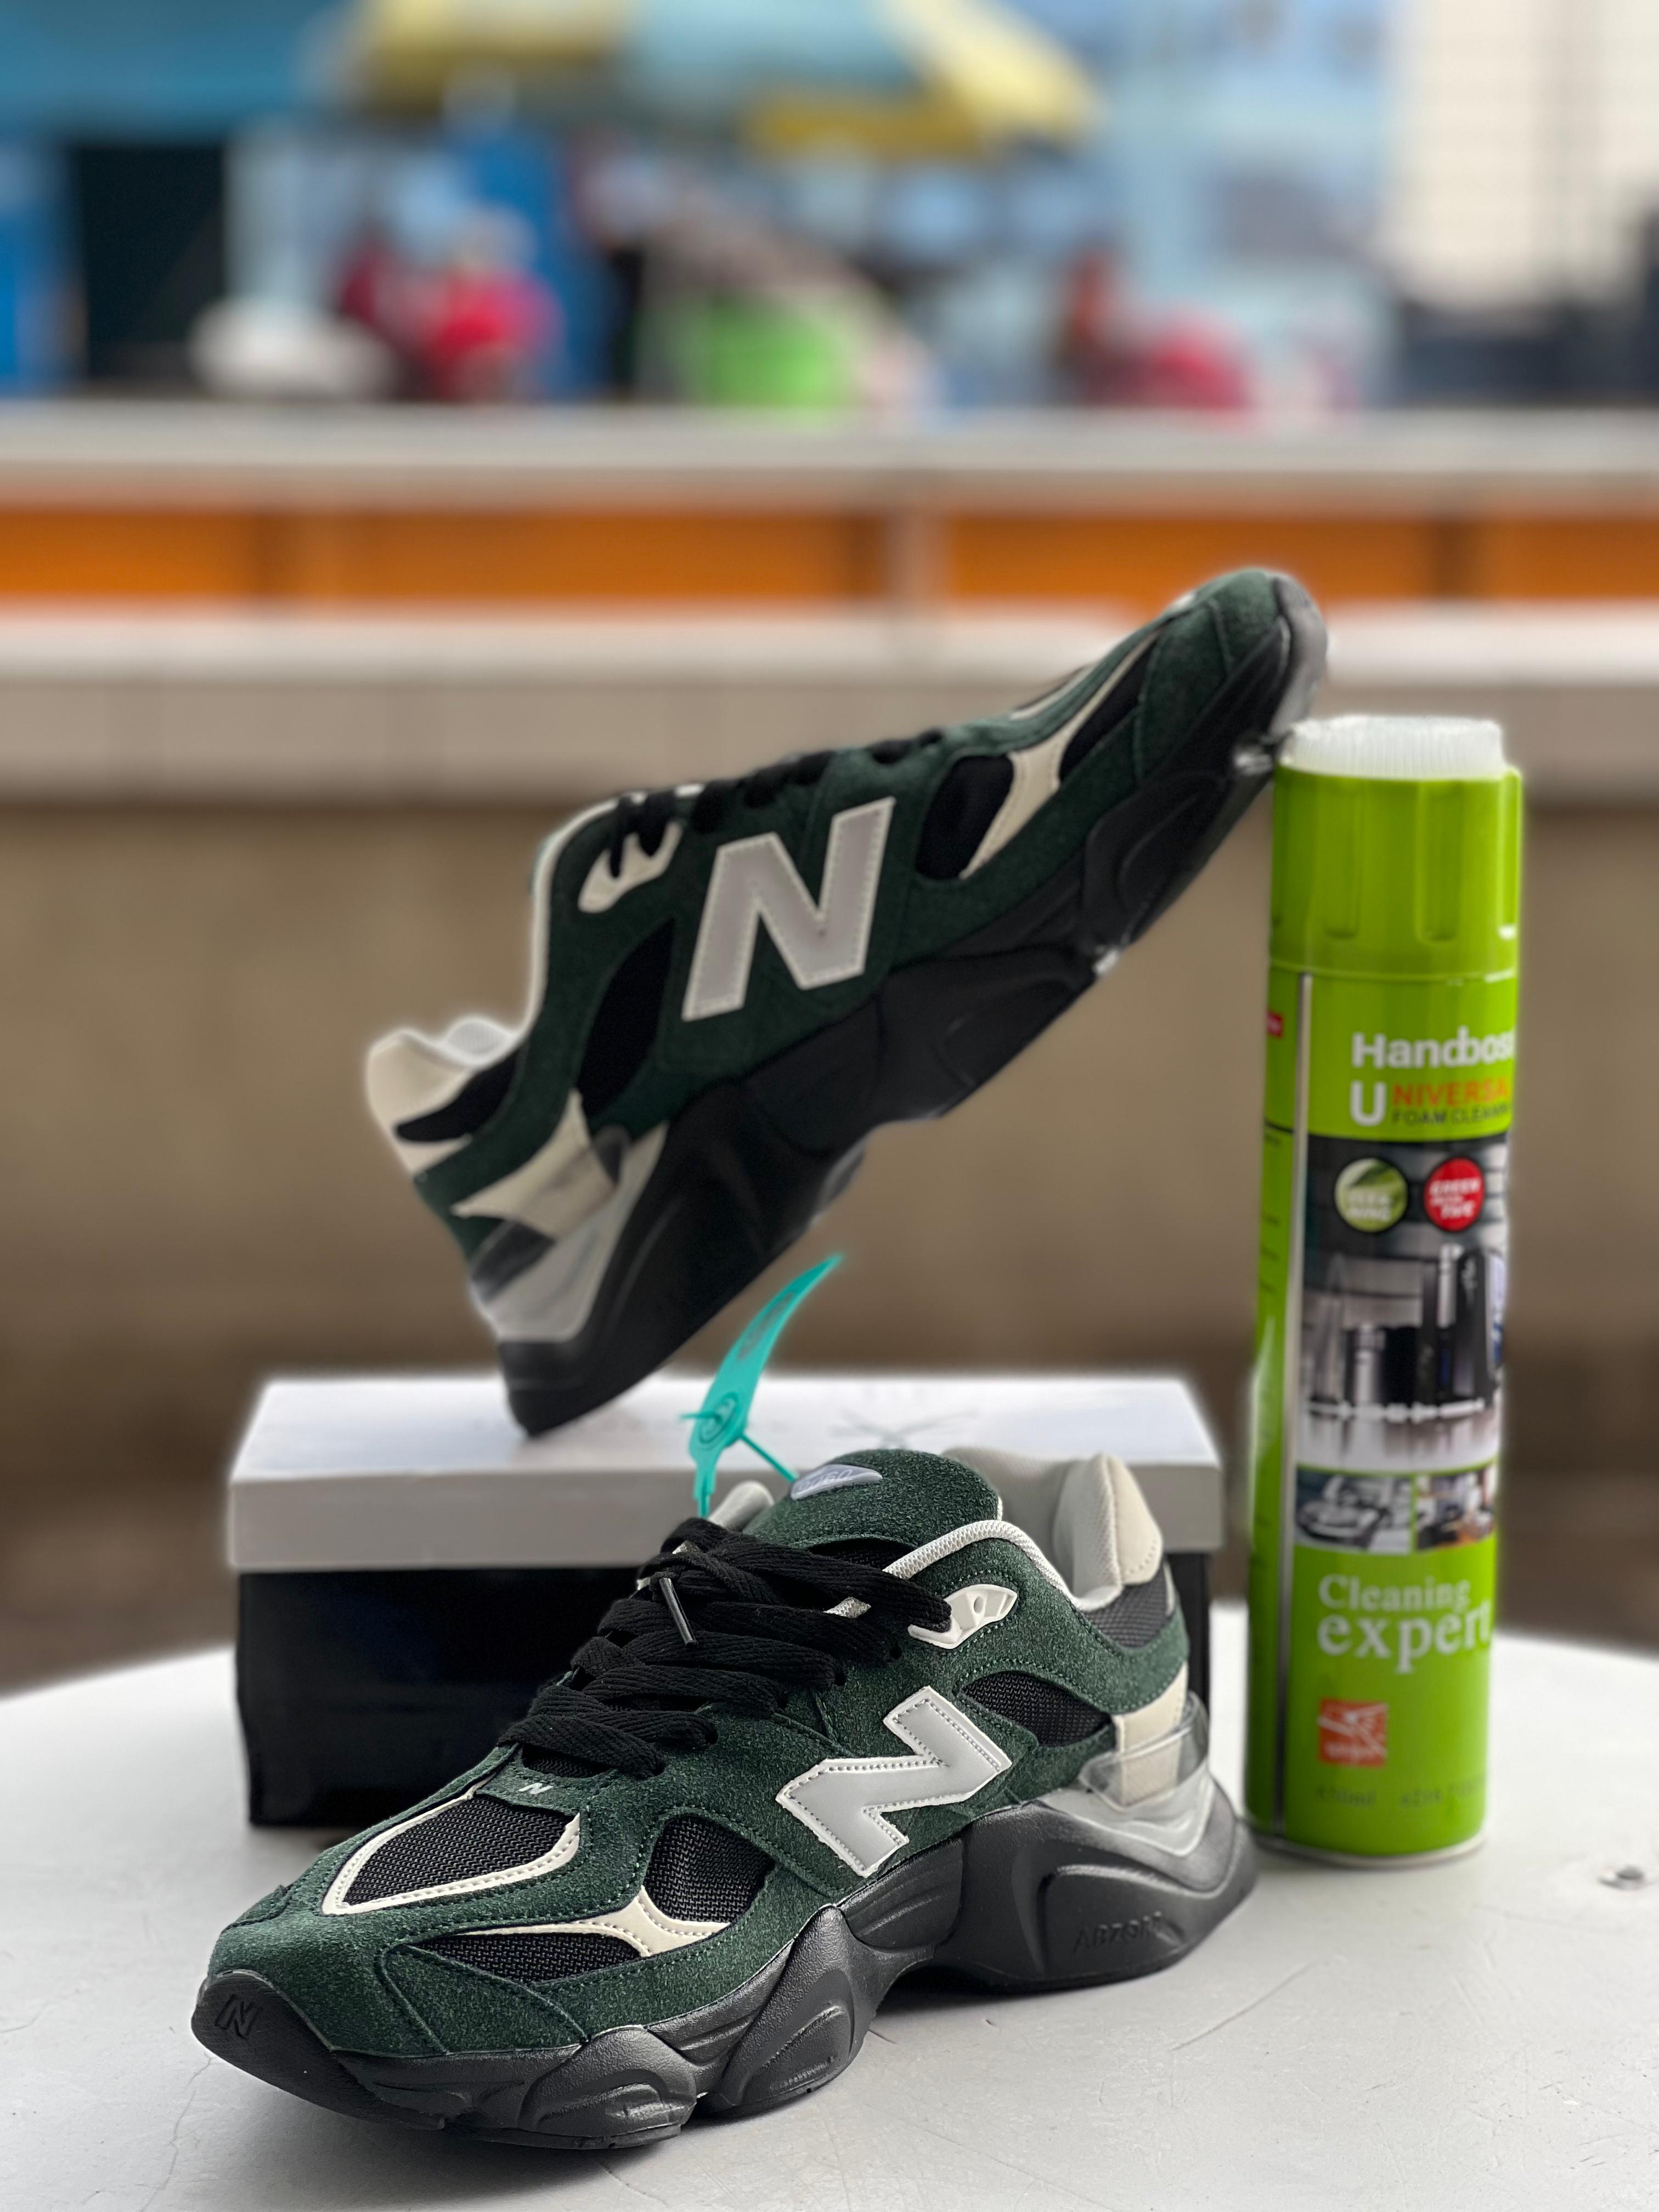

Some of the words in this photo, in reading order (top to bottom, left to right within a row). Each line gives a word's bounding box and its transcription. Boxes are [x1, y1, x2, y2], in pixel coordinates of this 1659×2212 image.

[681, 795, 897, 1022] N
[1318, 1573, 1471, 1615] Cleaning
[1317, 1599, 1491, 1675] expert
[518, 1782, 554, 1795] N
[775, 1685, 1013, 1878] N
[213, 1993, 257, 2041] N
